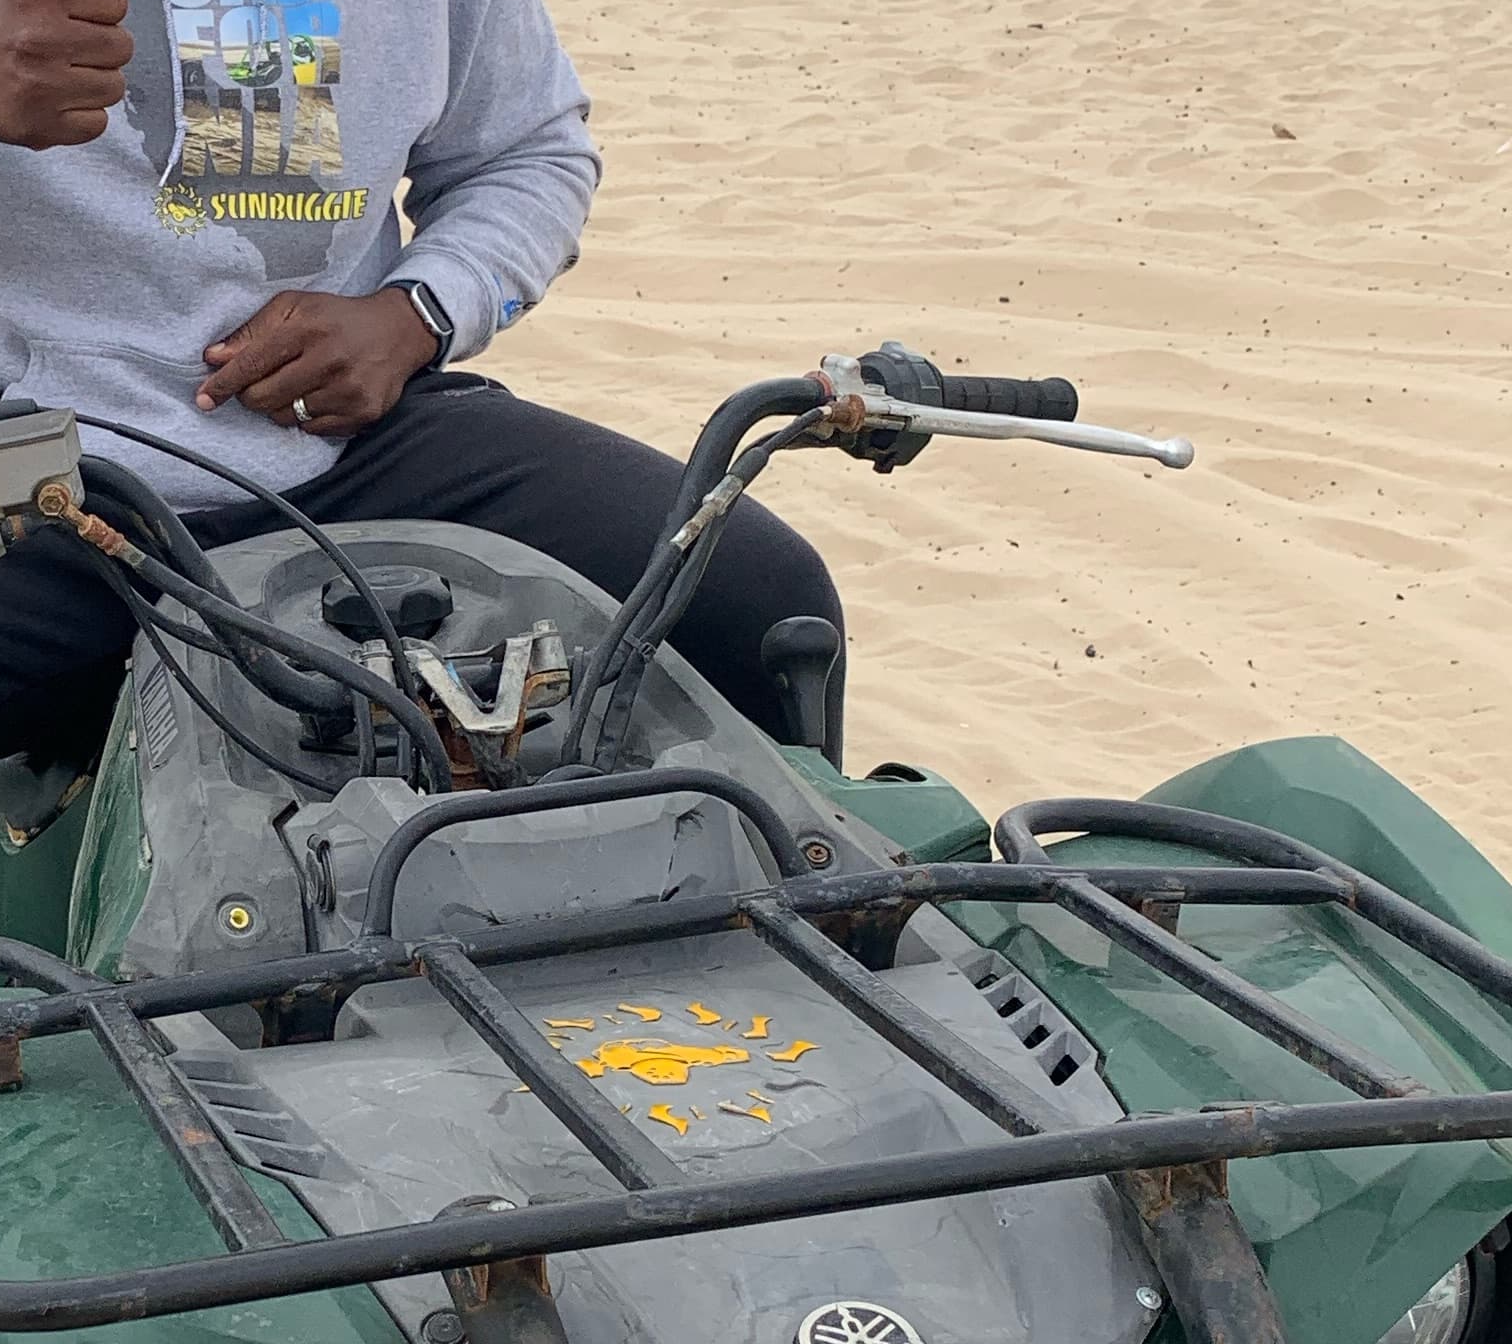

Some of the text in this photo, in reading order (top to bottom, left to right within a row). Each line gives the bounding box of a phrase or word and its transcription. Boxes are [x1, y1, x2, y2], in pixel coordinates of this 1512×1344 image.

[171, 4, 342, 87] FOR
[181, 87, 344, 177] NIA
[209, 187, 370, 223] SUNBUGGIE
